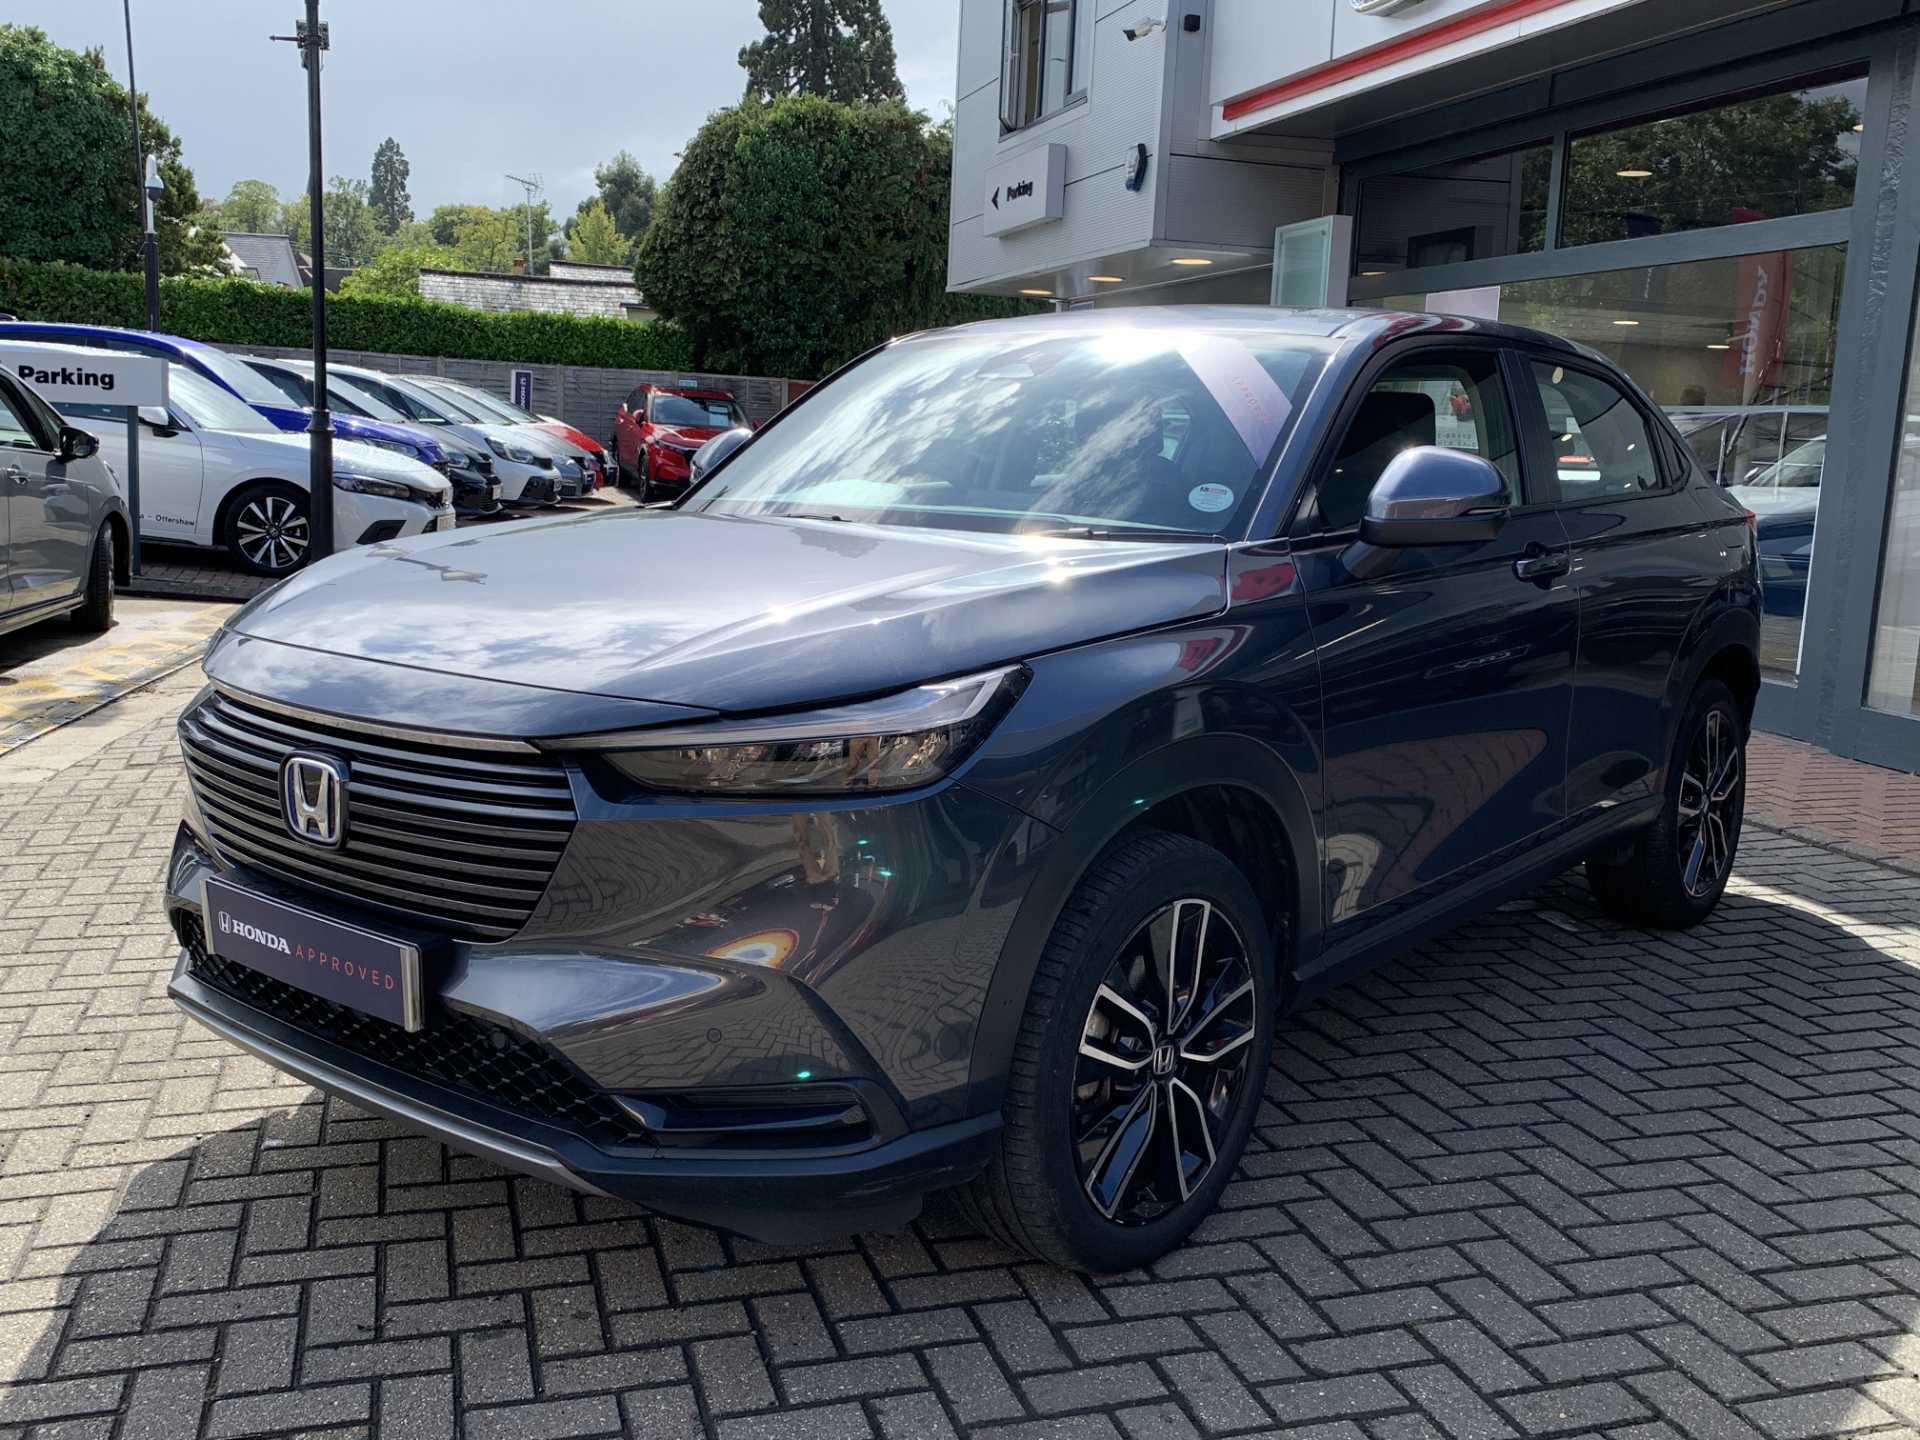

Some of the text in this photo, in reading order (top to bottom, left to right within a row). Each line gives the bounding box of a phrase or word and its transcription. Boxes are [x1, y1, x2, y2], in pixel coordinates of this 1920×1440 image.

[1006, 180, 1033, 202] Parking
[18, 364, 115, 391] Parking
[232, 919, 394, 990] HONDA APPROVED
